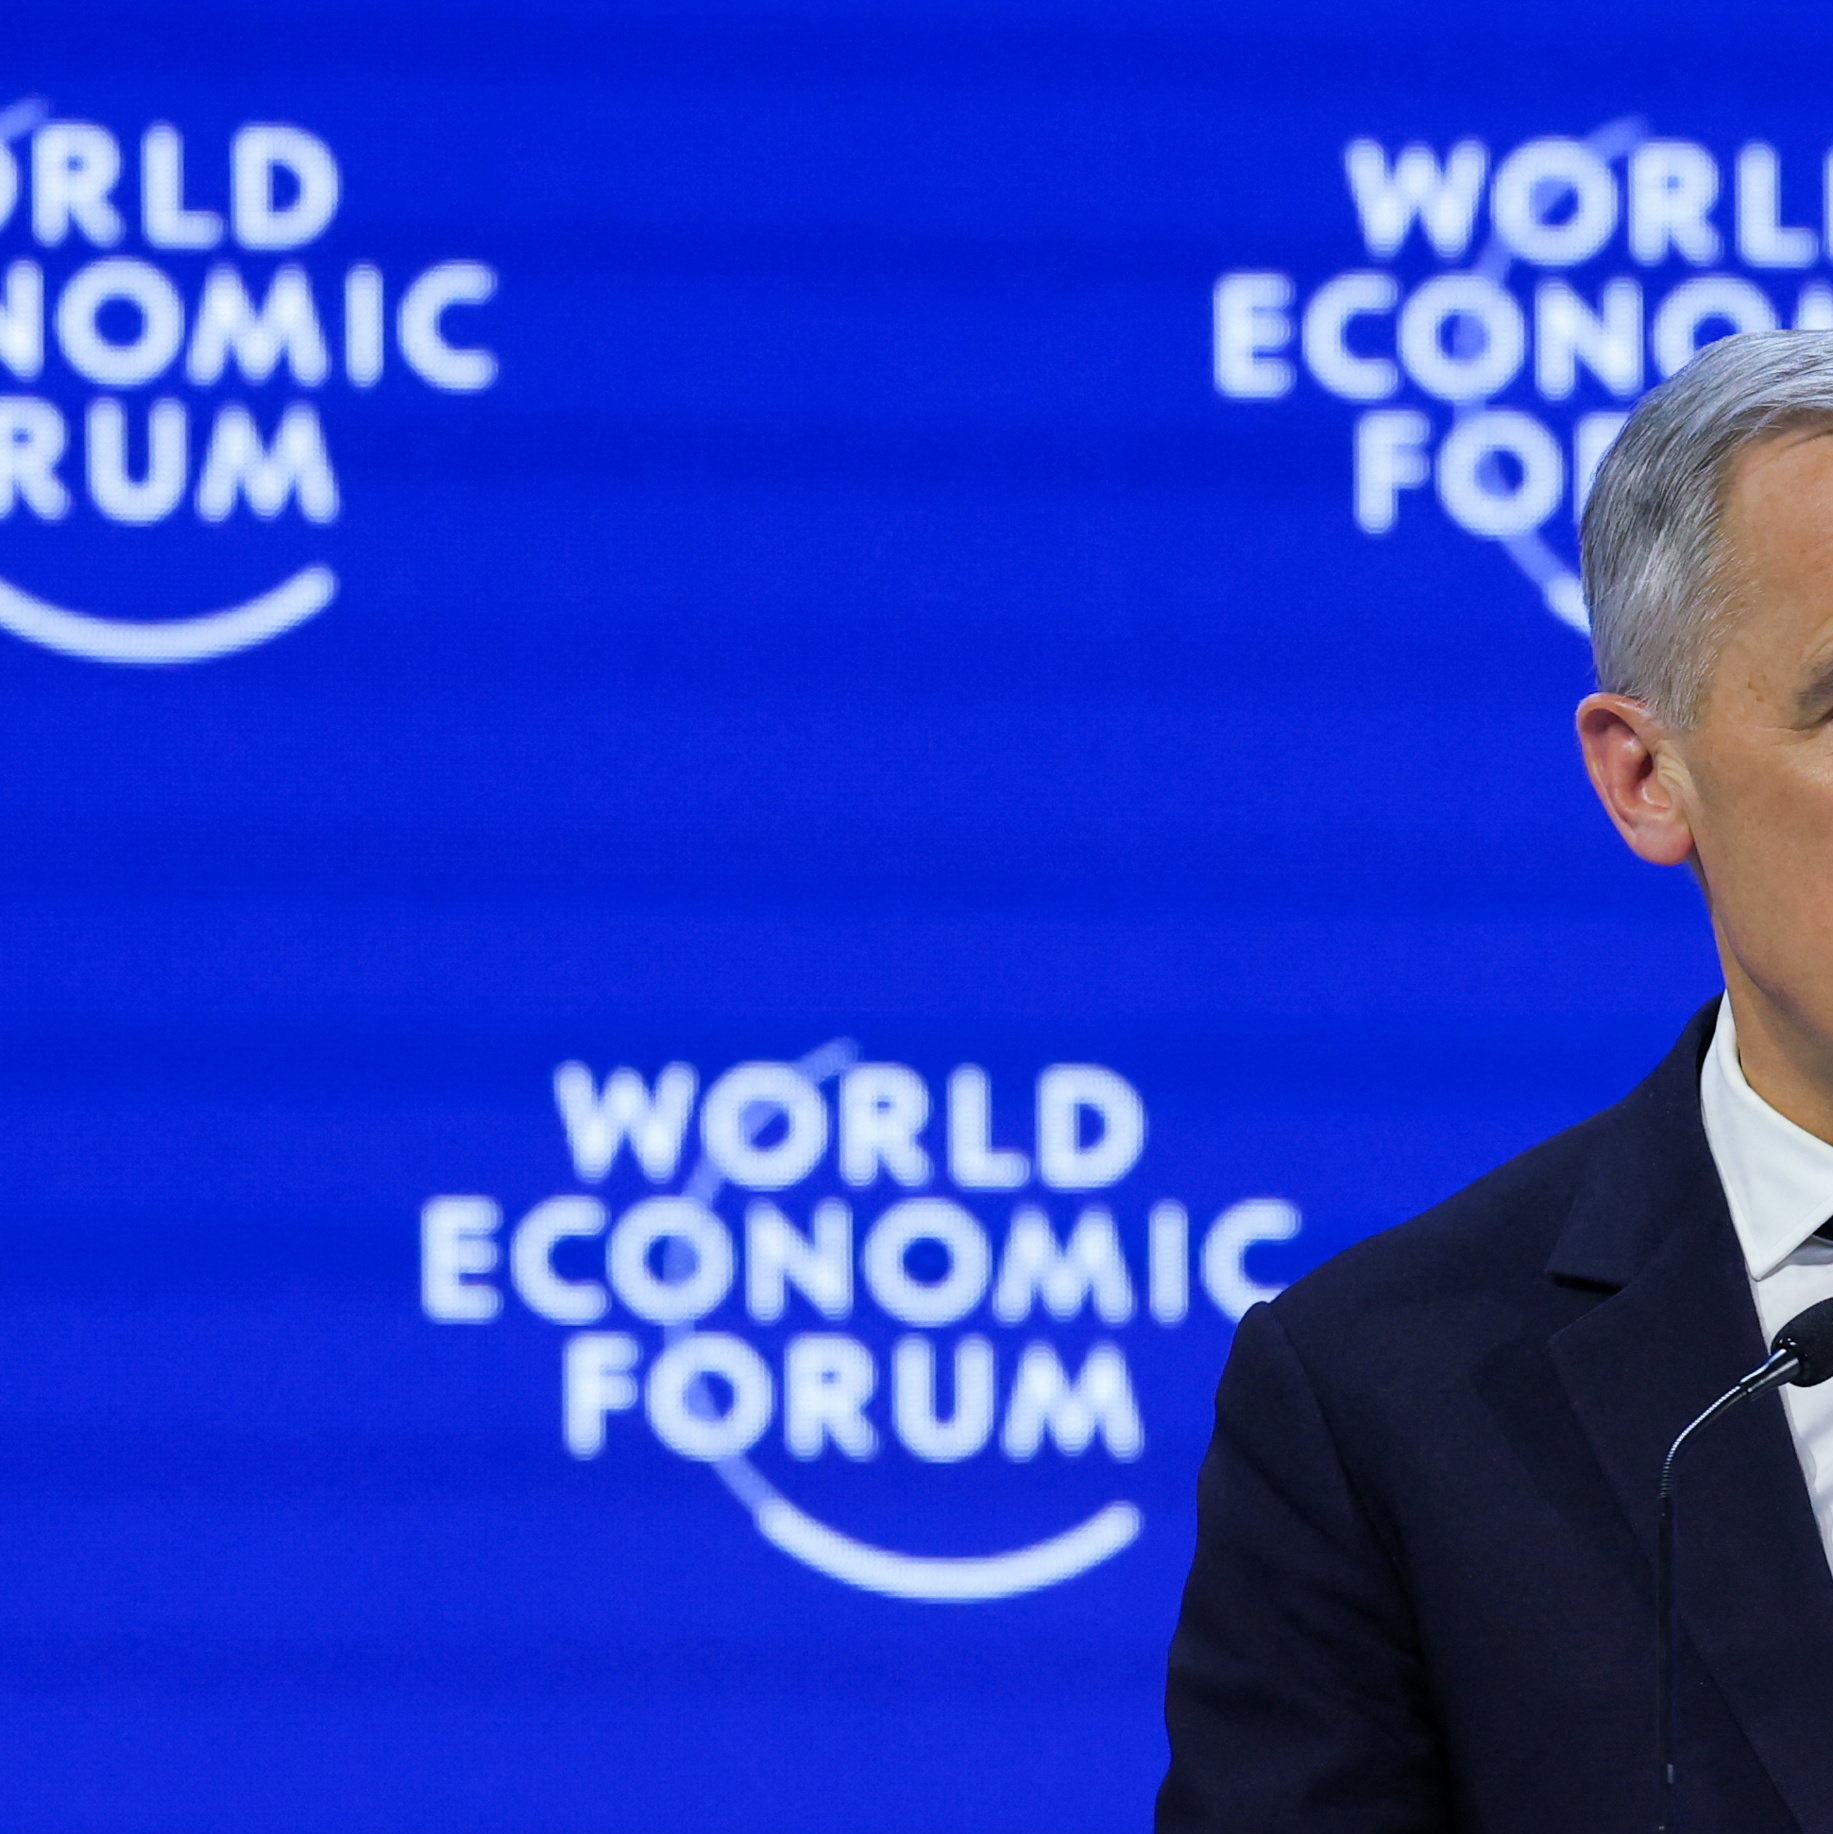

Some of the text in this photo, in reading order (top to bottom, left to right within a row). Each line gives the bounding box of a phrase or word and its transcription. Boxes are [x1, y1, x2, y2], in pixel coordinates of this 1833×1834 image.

[0, 122, 341, 251] RLD
[555, 1060, 1146, 1192] WORLD
[420, 1194, 1300, 1329] ECONOMIC
[564, 1330, 1142, 1464] FORUM
